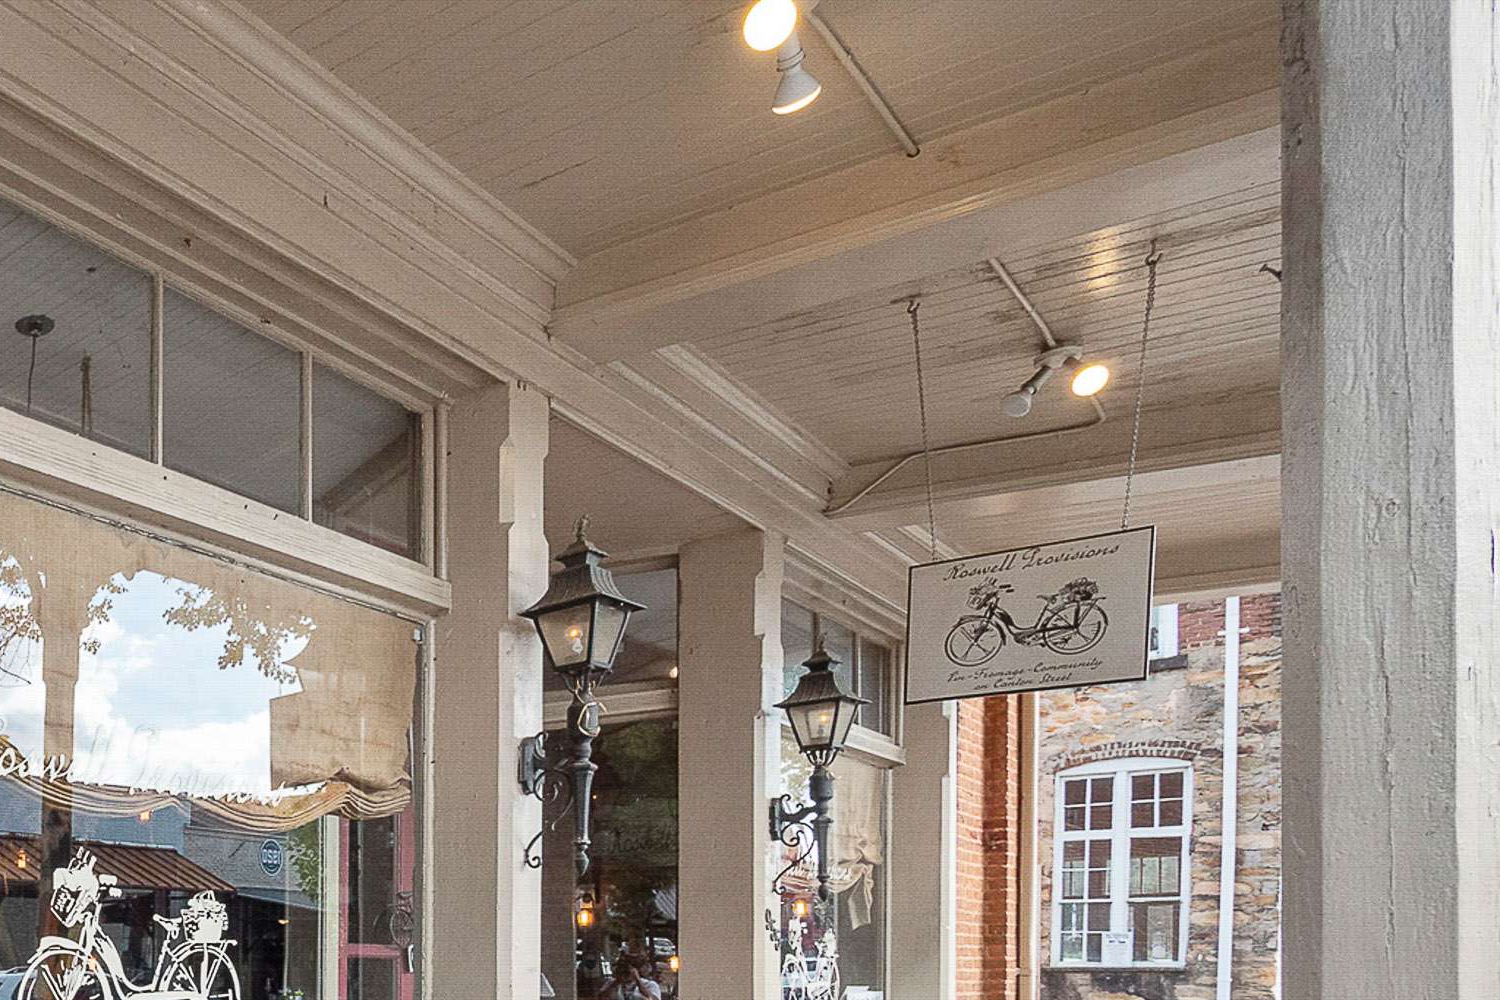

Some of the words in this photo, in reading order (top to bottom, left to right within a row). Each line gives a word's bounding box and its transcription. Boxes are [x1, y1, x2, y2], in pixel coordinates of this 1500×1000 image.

[943, 553, 1018, 582] Roswell
[1021, 545, 1121, 570] Provisions
[993, 678, 1033, 689] Canton
[1038, 672, 1073, 684] Street
